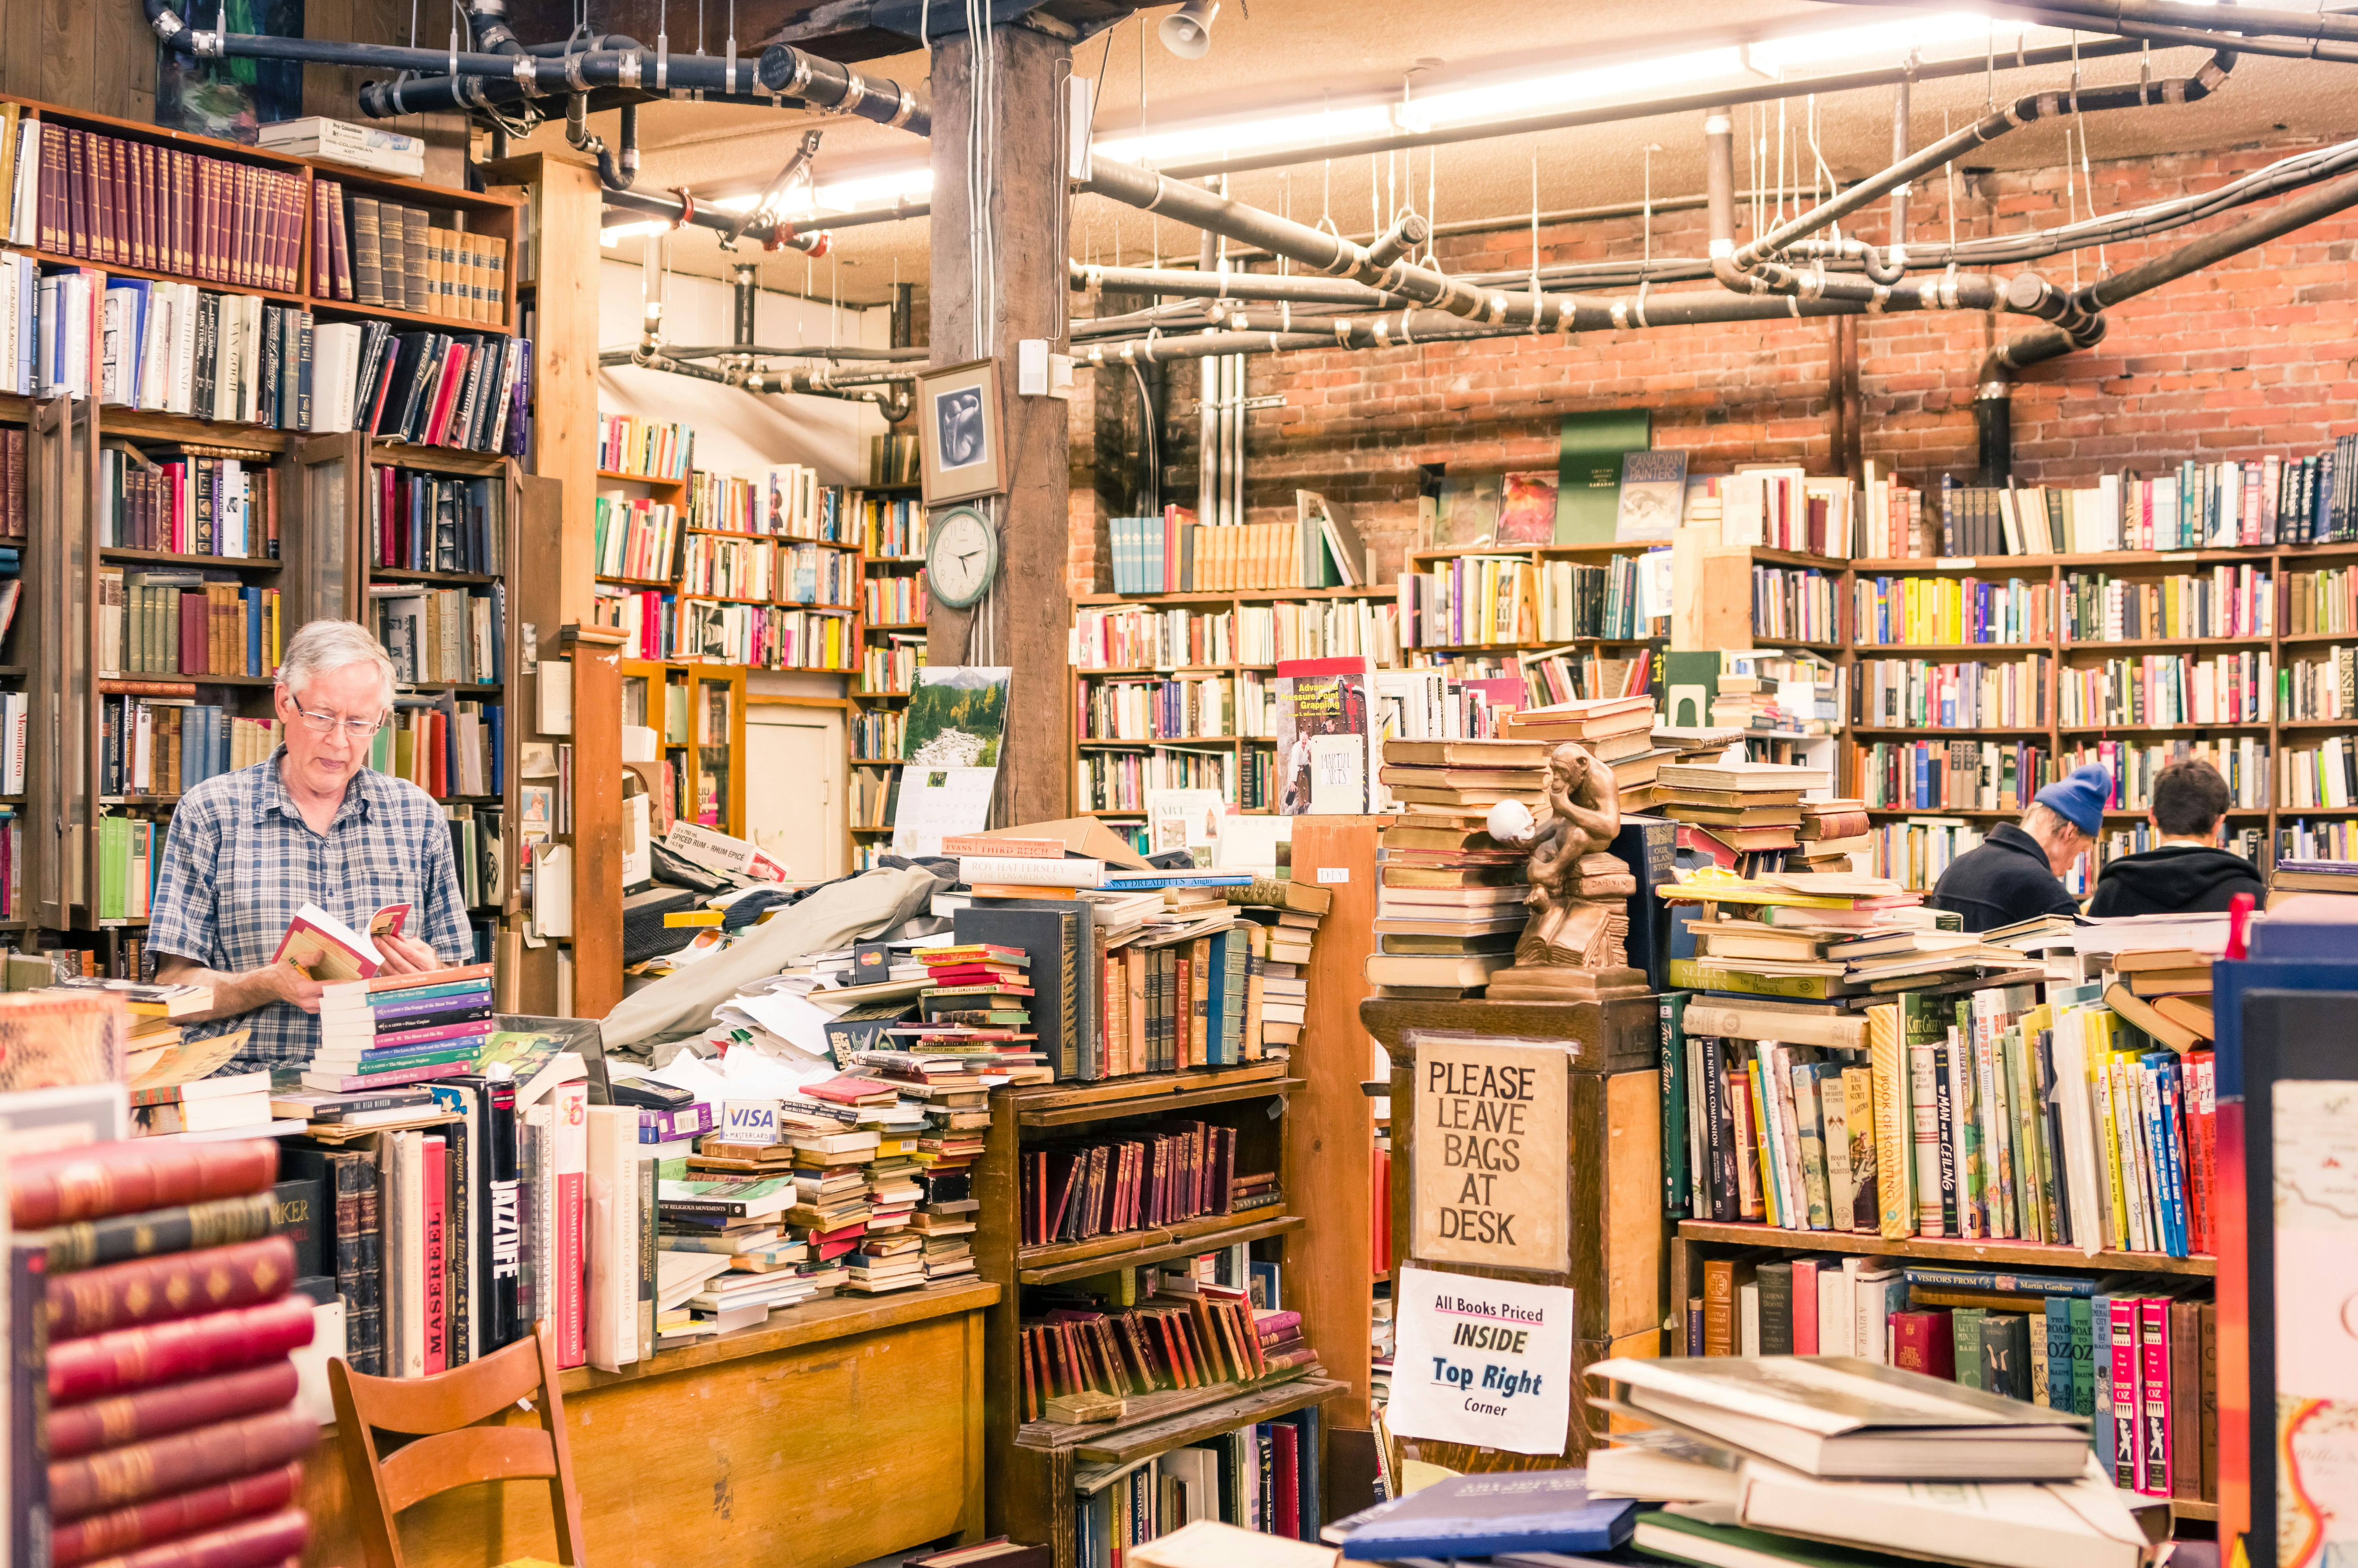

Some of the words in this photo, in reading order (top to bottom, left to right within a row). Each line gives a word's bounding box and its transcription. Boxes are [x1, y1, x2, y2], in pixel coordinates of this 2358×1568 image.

[333, 122, 362, 134] Pre-Columbian
[325, 139, 373, 153] PRE-COLUMBIAN
[229, 321, 240, 349] VAN
[228, 353, 238, 392] GOGH
[1628, 453, 1683, 468] CANADIAN
[1629, 467, 1678, 481] PAINTERS
[950, 525, 956, 536] 11
[960, 519, 968, 531] 12
[942, 537, 950, 550] 10
[979, 533, 984, 545] 2
[937, 553, 943, 565] 9
[940, 569, 946, 581] 8
[978, 567, 984, 576] 4
[948, 578, 955, 591] 7
[970, 578, 976, 590] 5
[1298, 683, 1338, 692] Advanced
[2340, 651, 2354, 711] RUSSELL
[1280, 693, 1316, 701] Pressure
[1318, 691, 1339, 700] Point
[1300, 700, 1340, 710] Grappling
[1321, 752, 1351, 769] MARTIAL
[1327, 769, 1347, 785] ARTS
[1161, 806, 1185, 815] ART
[671, 833, 692, 844] SPICED
[692, 840, 706, 849] RUM
[710, 845, 728, 855] RHUM
[728, 849, 745, 861] ÉPICÉ
[980, 846, 1013, 855] THIRD
[1017, 847, 1048, 856] REICH
[1654, 846, 1668, 855] OUR
[1648, 853, 1674, 864] ISLAND
[972, 862, 995, 872] ROY
[997, 862, 1067, 873] HATTERSLEY
[997, 873, 1057, 881] EDWARDIANS
[1104, 880, 1128, 889] ENNY
[1131, 878, 1185, 888] DREADFULS
[1191, 878, 1212, 886] Anglo
[1591, 879, 1627, 888] DARWIN
[1682, 979, 1728, 991] FABLES
[1740, 977, 1750, 987] by
[1753, 974, 1784, 984] Thomas
[1753, 983, 1781, 993] Bewick
[1976, 998, 1987, 1016] The
[1906, 1015, 1922, 1034] KATE
[1978, 1017, 1991, 1066] RUPERT
[1429, 1061, 1536, 1101] PLEASE
[1851, 1083, 1862, 1092] BOY
[1981, 1067, 1993, 1098] Annual
[1849, 1091, 1865, 1100] SCOUT
[1881, 1075, 1891, 1110] BOOK
[1938, 1095, 1951, 1122] MAN
[727, 1108, 774, 1128] VISA
[1436, 1098, 1527, 1136] LEAVE
[1710, 1095, 1718, 1147] COMPANION
[1882, 1116, 1892, 1130] OF
[1941, 1130, 1949, 1142] THE
[455, 1135, 466, 1181] Saroyan
[1444, 1133, 1521, 1172] BAGS
[1884, 1134, 1895, 1199] SCOUTING
[1940, 1143, 1956, 1191] CEILING
[1458, 1173, 1497, 1206] AT
[456, 1199, 466, 1234] Morris
[489, 1180, 519, 1280] JAZZLIFE
[1439, 1207, 1516, 1246] DESK
[457, 1237, 467, 1290] Hirshfield
[623, 1255, 630, 1267] OF
[428, 1211, 442, 1356] MASEREEL
[1917, 1275, 1952, 1284] VISITORS
[2020, 1282, 2043, 1290] Martin
[2044, 1282, 2073, 1292] Gardner
[689, 1299, 708, 1308] Oklahoma
[1435, 1295, 1452, 1311] All
[1457, 1298, 1496, 1316] Books
[1501, 1304, 1543, 1322] Priced
[569, 1314, 577, 1357] HISTORY
[2047, 1324, 2071, 1333] ROAD
[1453, 1322, 1528, 1354] INSIDE
[1900, 1351, 1920, 1360] CORAL
[2047, 1343, 2072, 1358] OZ
[1898, 1358, 1921, 1367] ISLAND
[1432, 1357, 1474, 1391] Top
[1481, 1364, 1543, 1398] Right
[2116, 1391, 2130, 1400] OZ
[1464, 1397, 1507, 1417] Corner
[1374, 1431, 1386, 1470] sonomama
